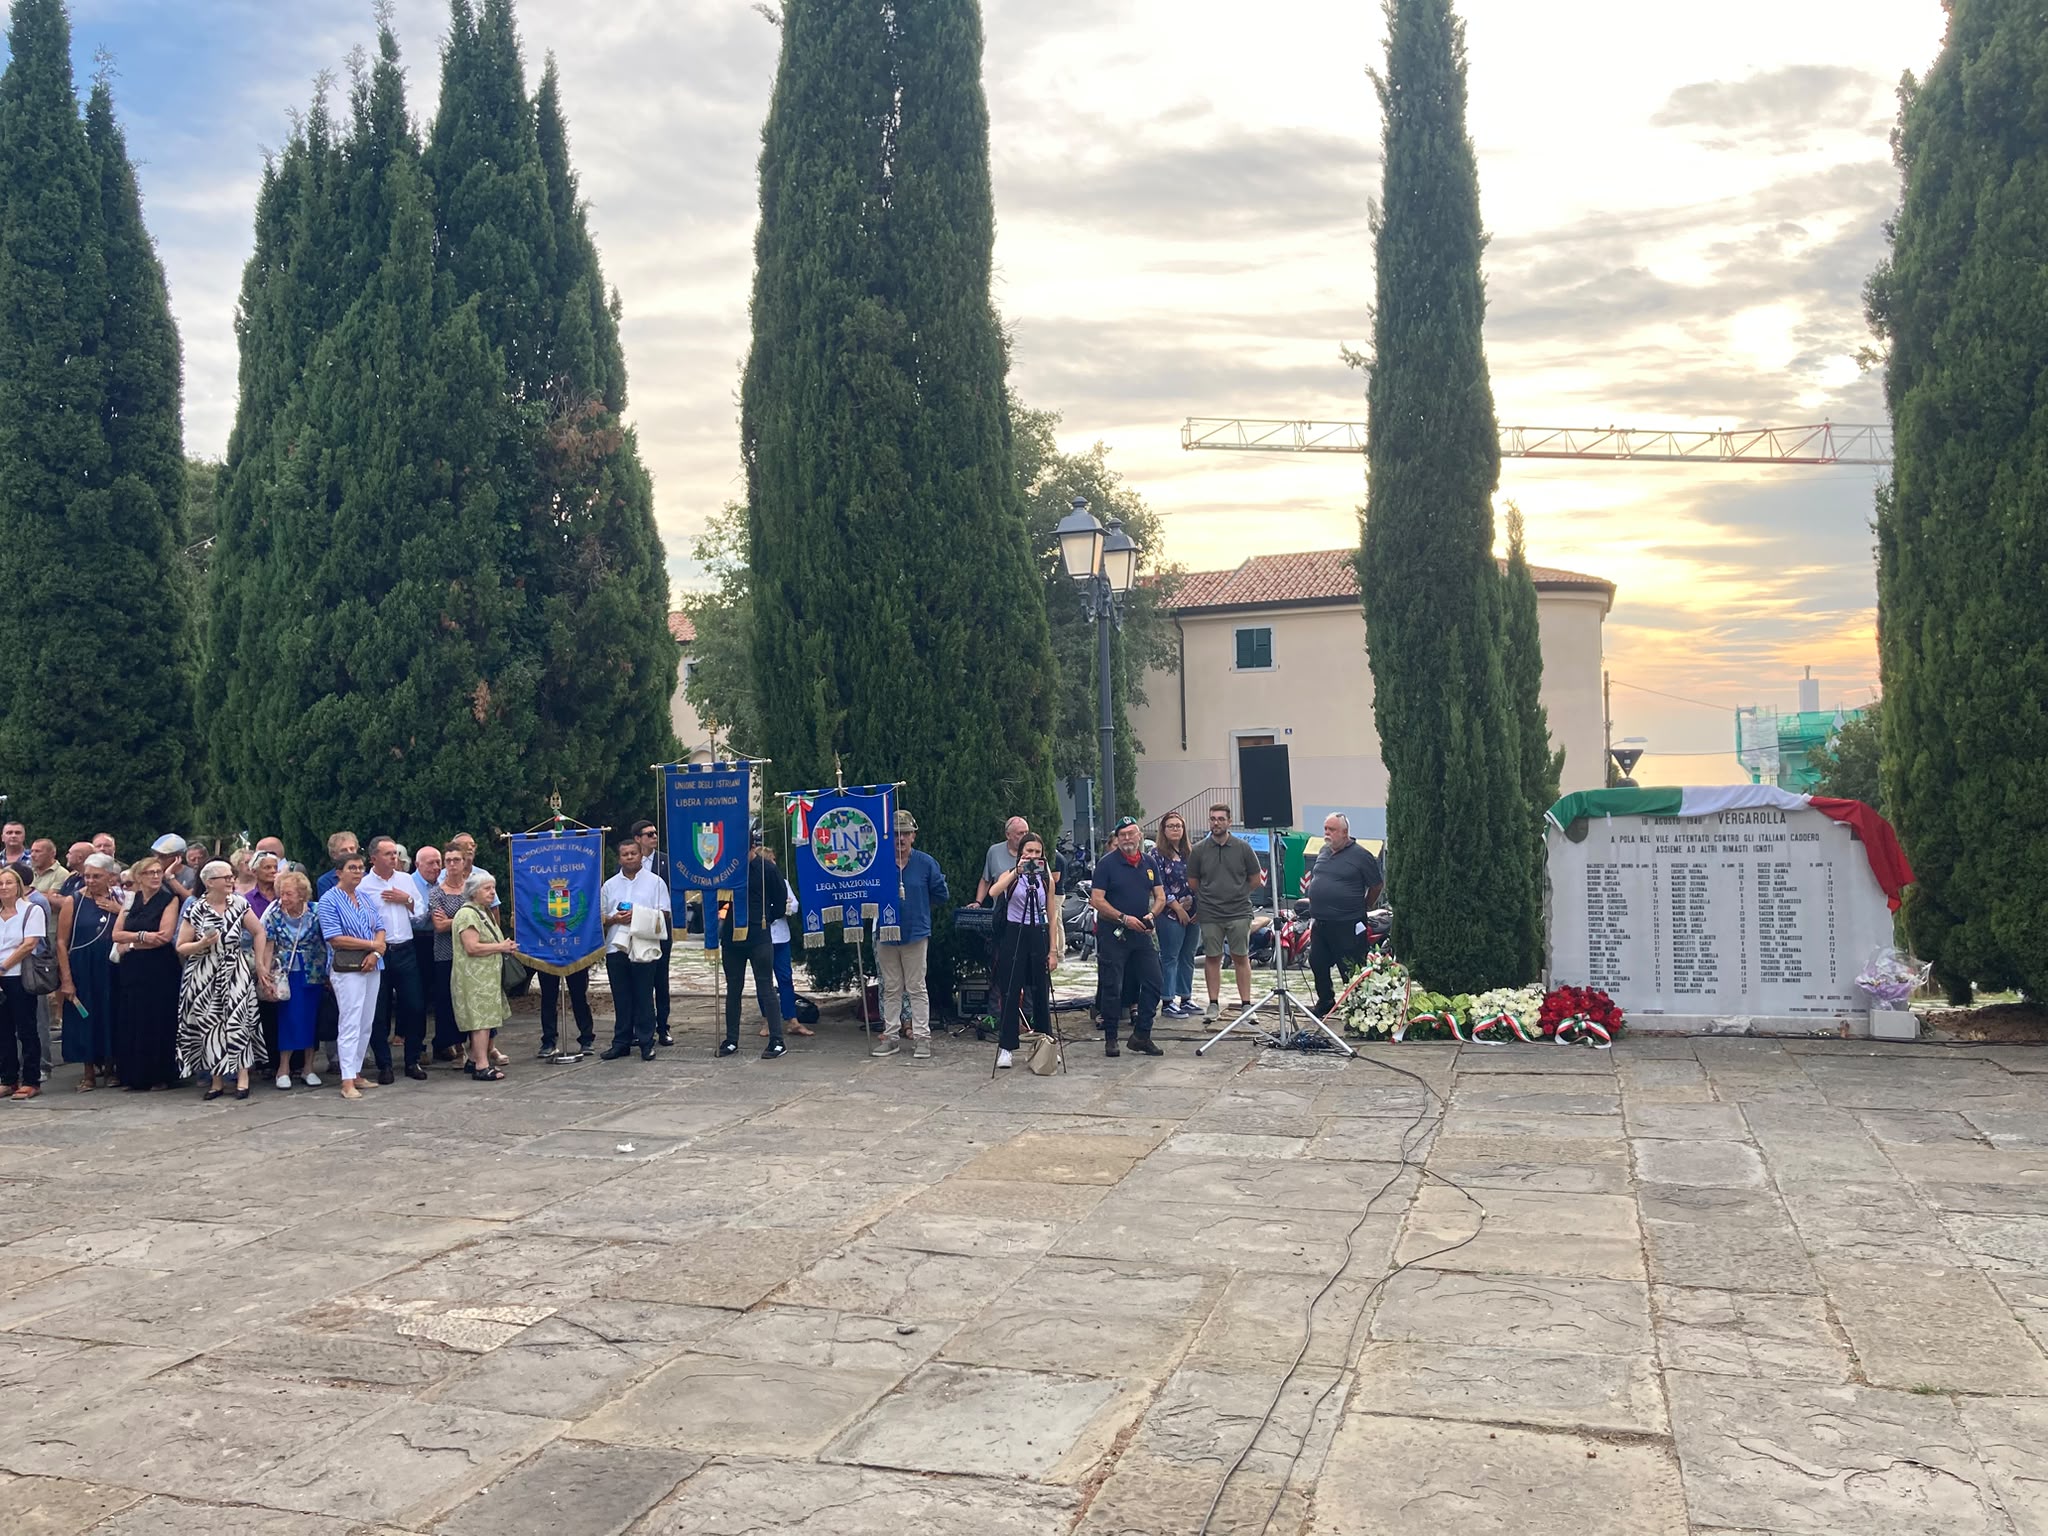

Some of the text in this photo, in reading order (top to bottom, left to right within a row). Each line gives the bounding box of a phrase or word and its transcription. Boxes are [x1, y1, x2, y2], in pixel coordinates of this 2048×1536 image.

[675, 781, 695, 789] UNIONE
[698, 780, 713, 788] DEGLI
[676, 796, 737, 807] LIBERA PROVINCIA
[1718, 812, 1786, 824] VERGAROLLA
[1620, 835, 1635, 843] POLA
[1640, 835, 1650, 843] NEL
[1674, 834, 1709, 842] ATTENTATO
[1714, 834, 1739, 842] CONTRO
[1744, 834, 1754, 842] GLI
[1759, 834, 1786, 842] ITALIANI
[1790, 833, 1819, 841] CADDERO
[1656, 845, 1682, 853] ASSIEME
[1700, 845, 1717, 853] ALTRI
[1723, 845, 1748, 853] RIMASTI
[530, 866, 552, 874] POLA
[560, 863, 586, 872] ISTRIA
[720, 858, 739, 881] ESILIO
[816, 879, 880, 891] LEGA NAZIONALE
[832, 891, 868, 900] TRIESTE
